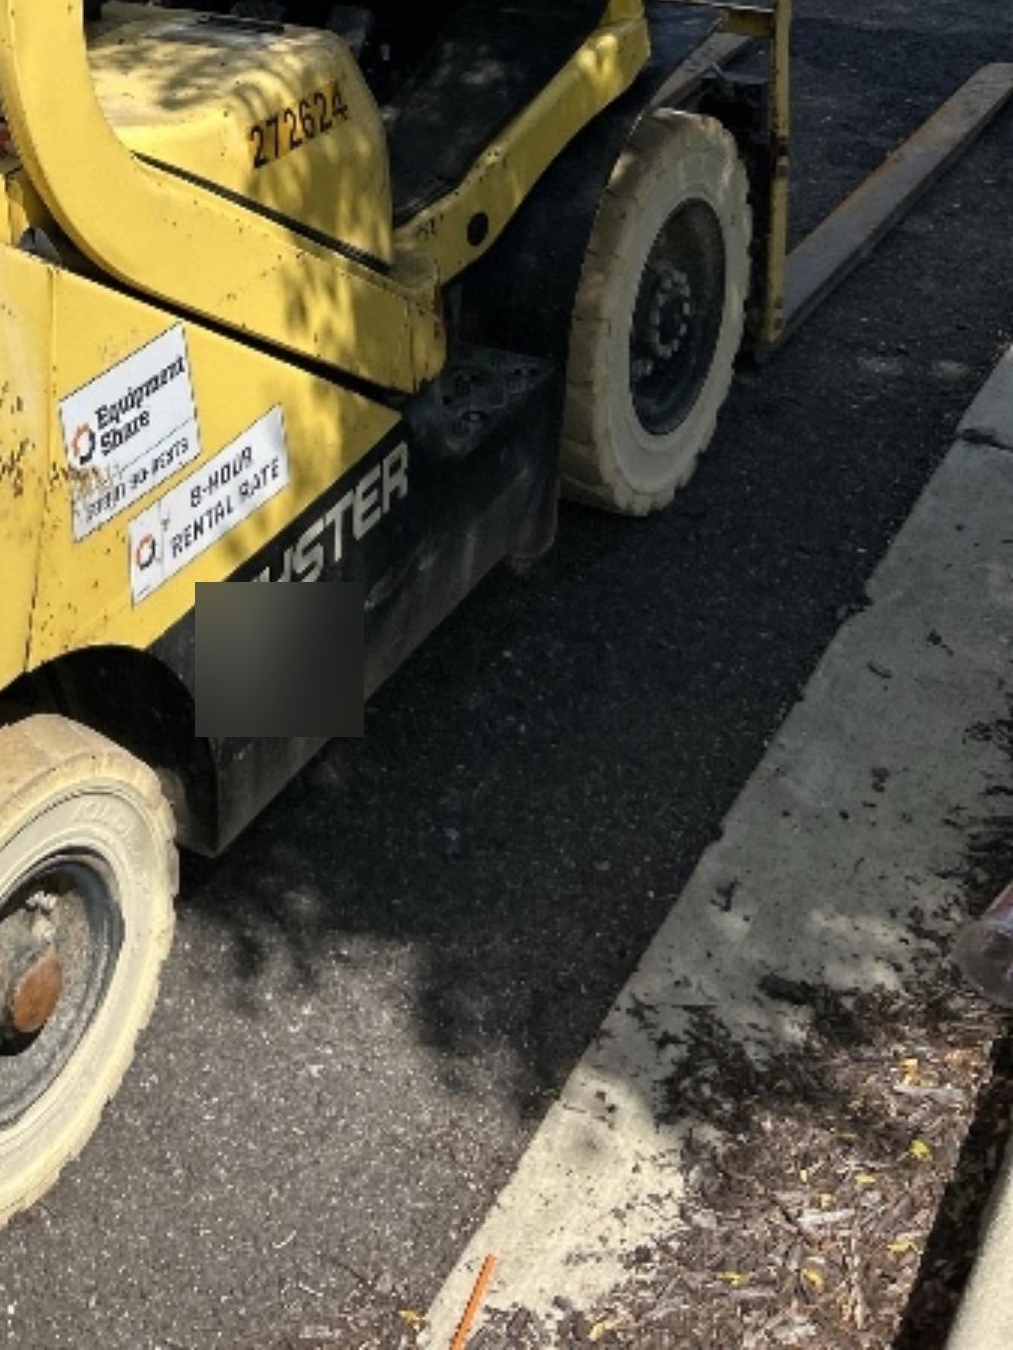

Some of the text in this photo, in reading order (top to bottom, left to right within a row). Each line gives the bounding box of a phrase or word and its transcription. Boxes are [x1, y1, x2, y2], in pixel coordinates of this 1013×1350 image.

[250, 77, 349, 168] 272624
[94, 354, 186, 429] Equipment
[99, 411, 151, 456] Share
[169, 498, 235, 558] RENTAL
[238, 457, 280, 500] RATE
[189, 446, 254, 509] 8-HOUR
[252, 441, 409, 582] STER
